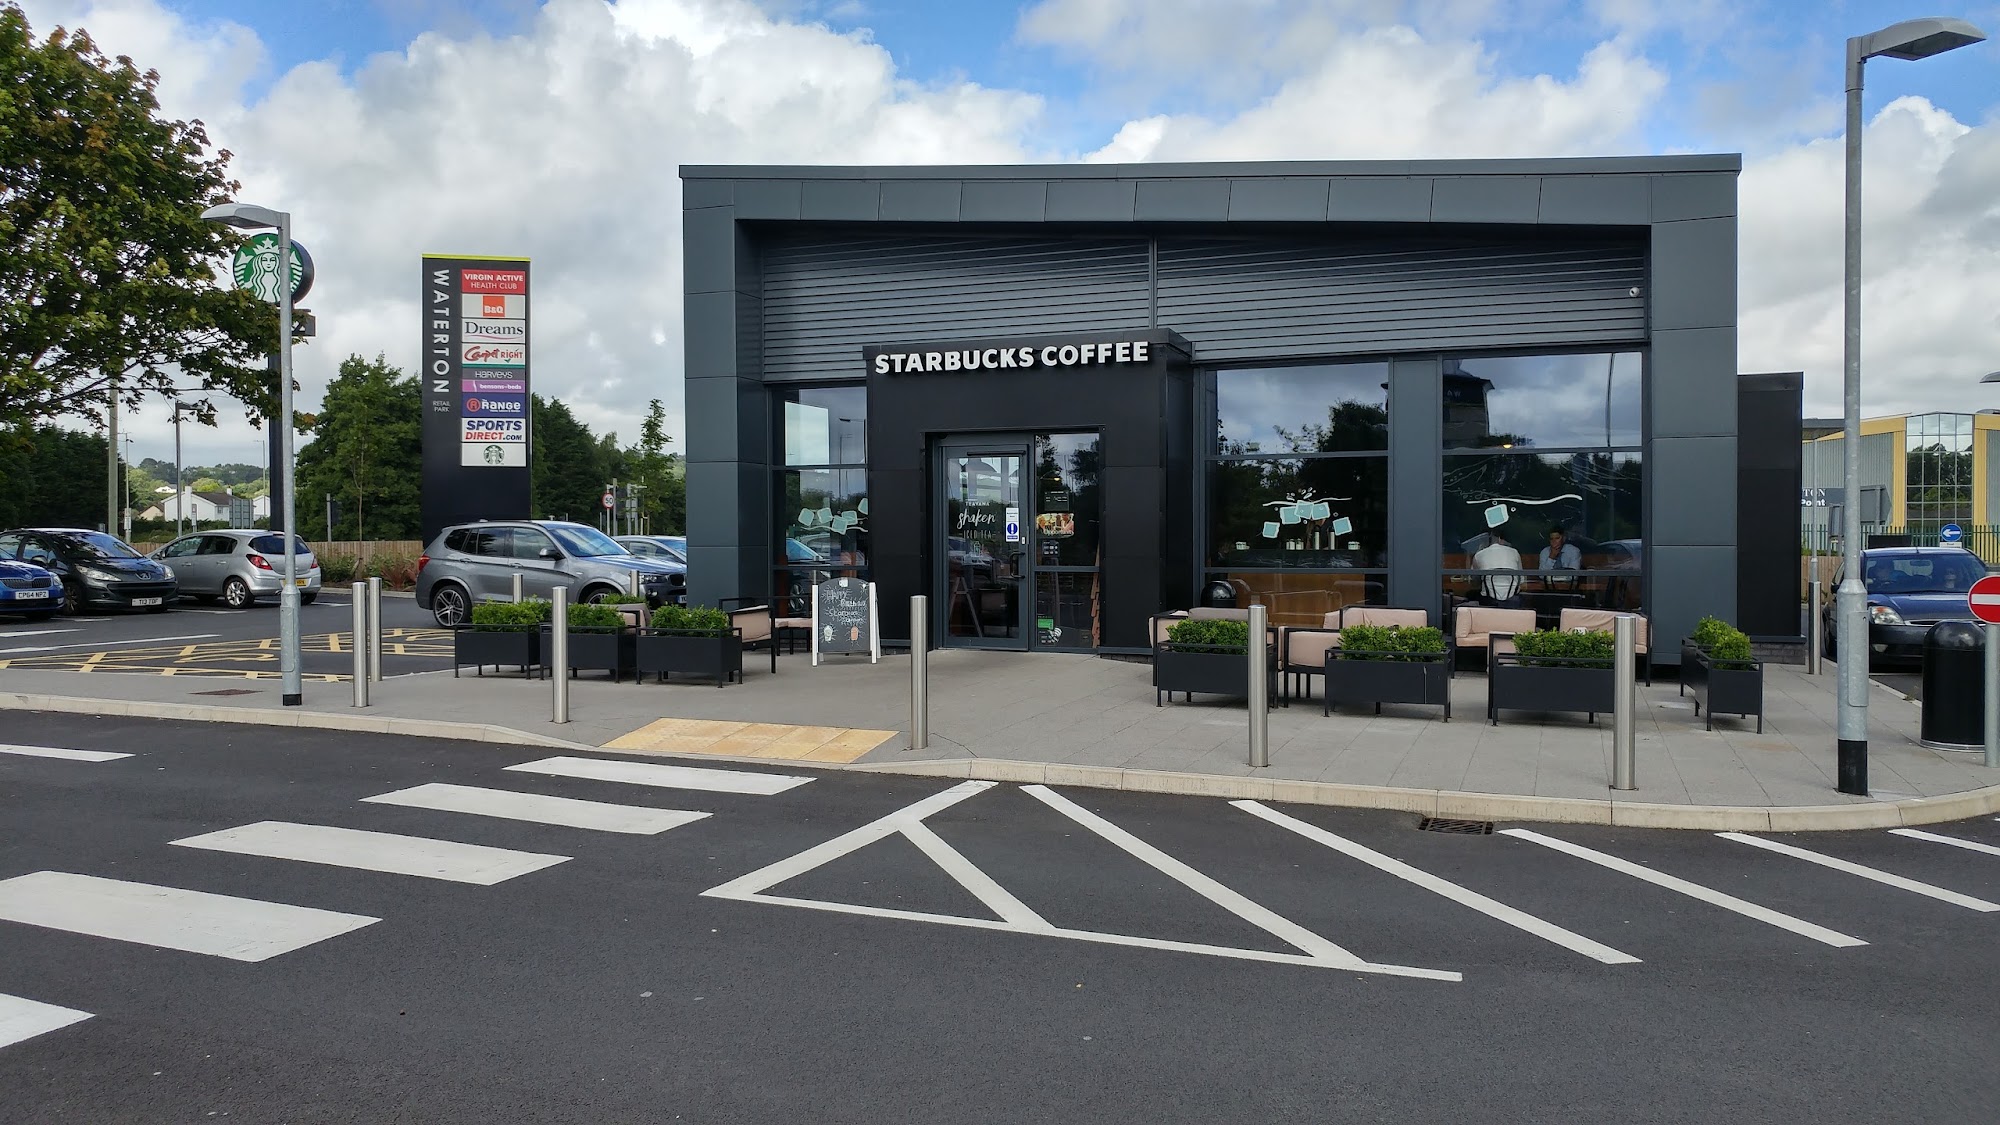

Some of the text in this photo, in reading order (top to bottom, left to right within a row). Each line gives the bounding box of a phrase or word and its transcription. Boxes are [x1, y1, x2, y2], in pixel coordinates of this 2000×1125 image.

[464, 273, 524, 282] VIRGIN ACTIVE
[484, 305, 504, 313] B&Q
[433, 269, 450, 393] WATERTON
[464, 322, 524, 335] Dreams
[464, 346, 500, 362] Carpet
[875, 341, 1149, 374] STARBUCKS COFFEE
[466, 420, 522, 431] SPORTS
[465, 432, 523, 441] DIRECT.COM
[956, 508, 996, 529] shaken
